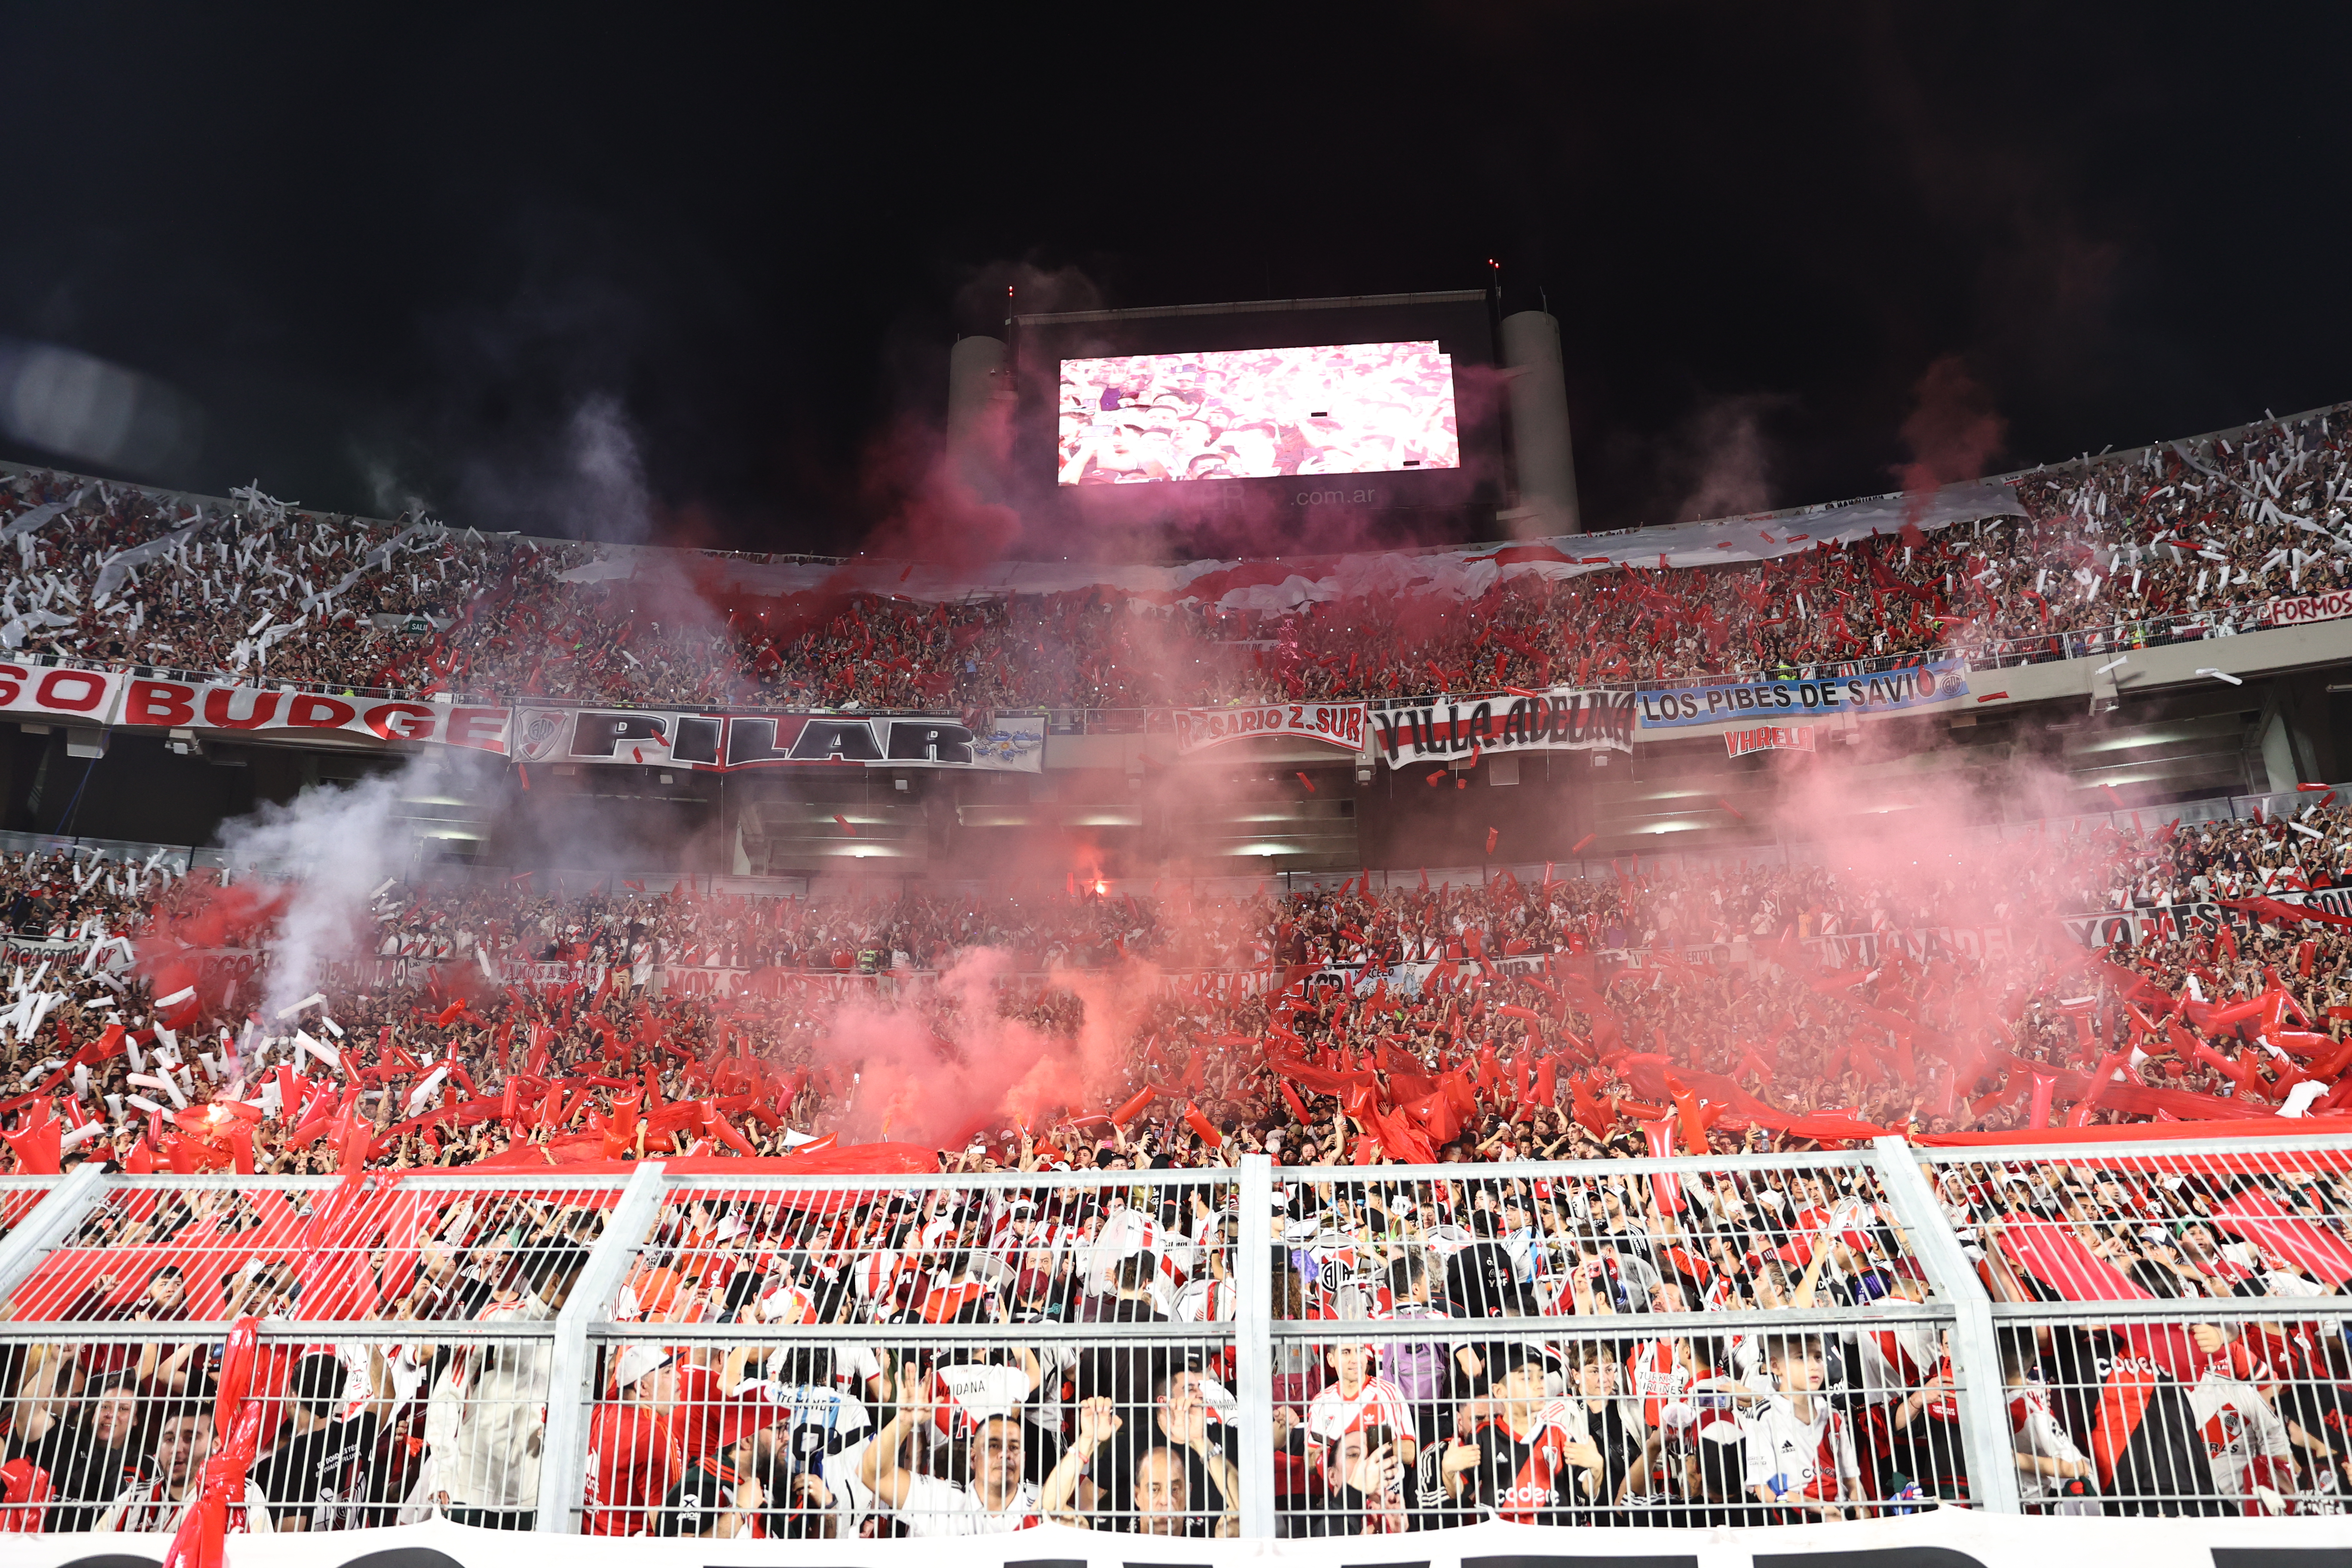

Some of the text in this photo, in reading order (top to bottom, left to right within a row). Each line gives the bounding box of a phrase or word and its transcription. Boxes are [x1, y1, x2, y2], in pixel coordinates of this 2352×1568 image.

[1642, 669, 1936, 722] LOS PIBES DE SAVIO
[125, 680, 511, 752] BUDGE
[1375, 691, 1635, 762] VILLA ADELINA
[568, 710, 975, 767] PILAR
[499, 965, 598, 986] VAMOS A ESTAR
[1355, 967, 1394, 980] MRCELO
[937, 1380, 985, 1396] MAIDANA
[1637, 1381, 1683, 1394] IRLINES
[1640, 1371, 1684, 1384] TURKISH
[325, 1452, 343, 1464] DOND
[1497, 1482, 1560, 1505] codere
